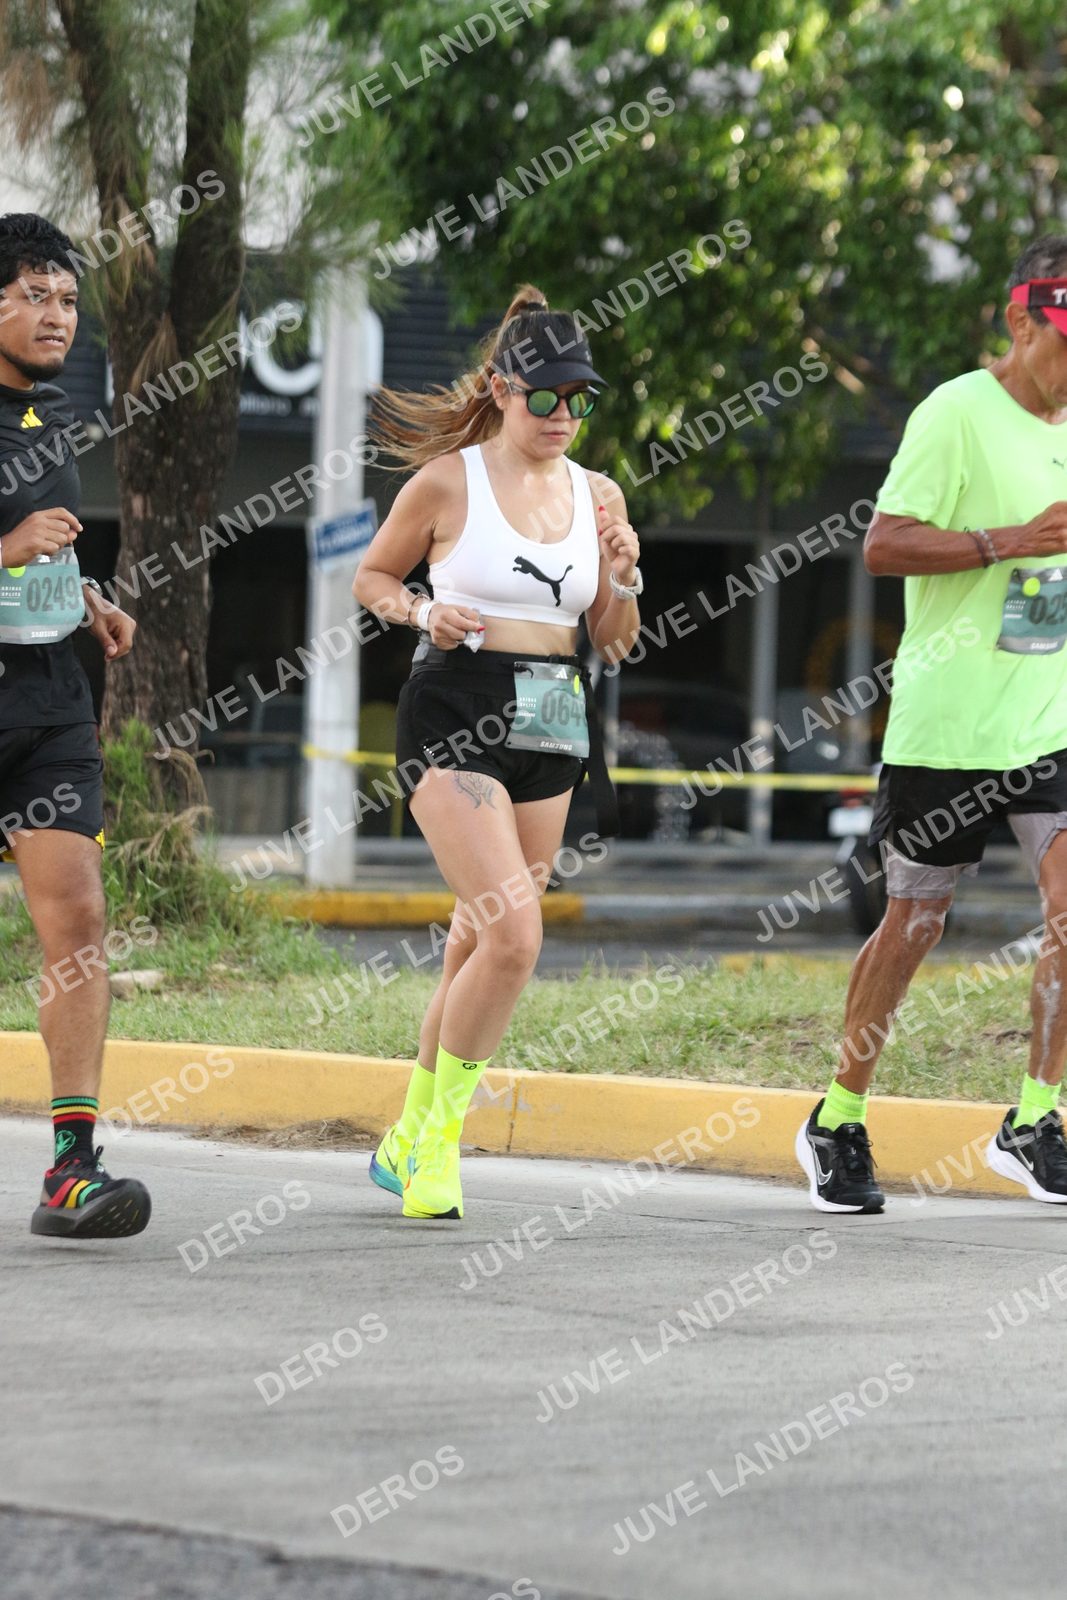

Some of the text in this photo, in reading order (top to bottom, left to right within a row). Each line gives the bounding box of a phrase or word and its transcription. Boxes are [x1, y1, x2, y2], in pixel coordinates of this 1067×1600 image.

[27, 575, 80, 613] 0249
[1029, 592, 1067, 625] 02
[541, 690, 588, 727] 064
